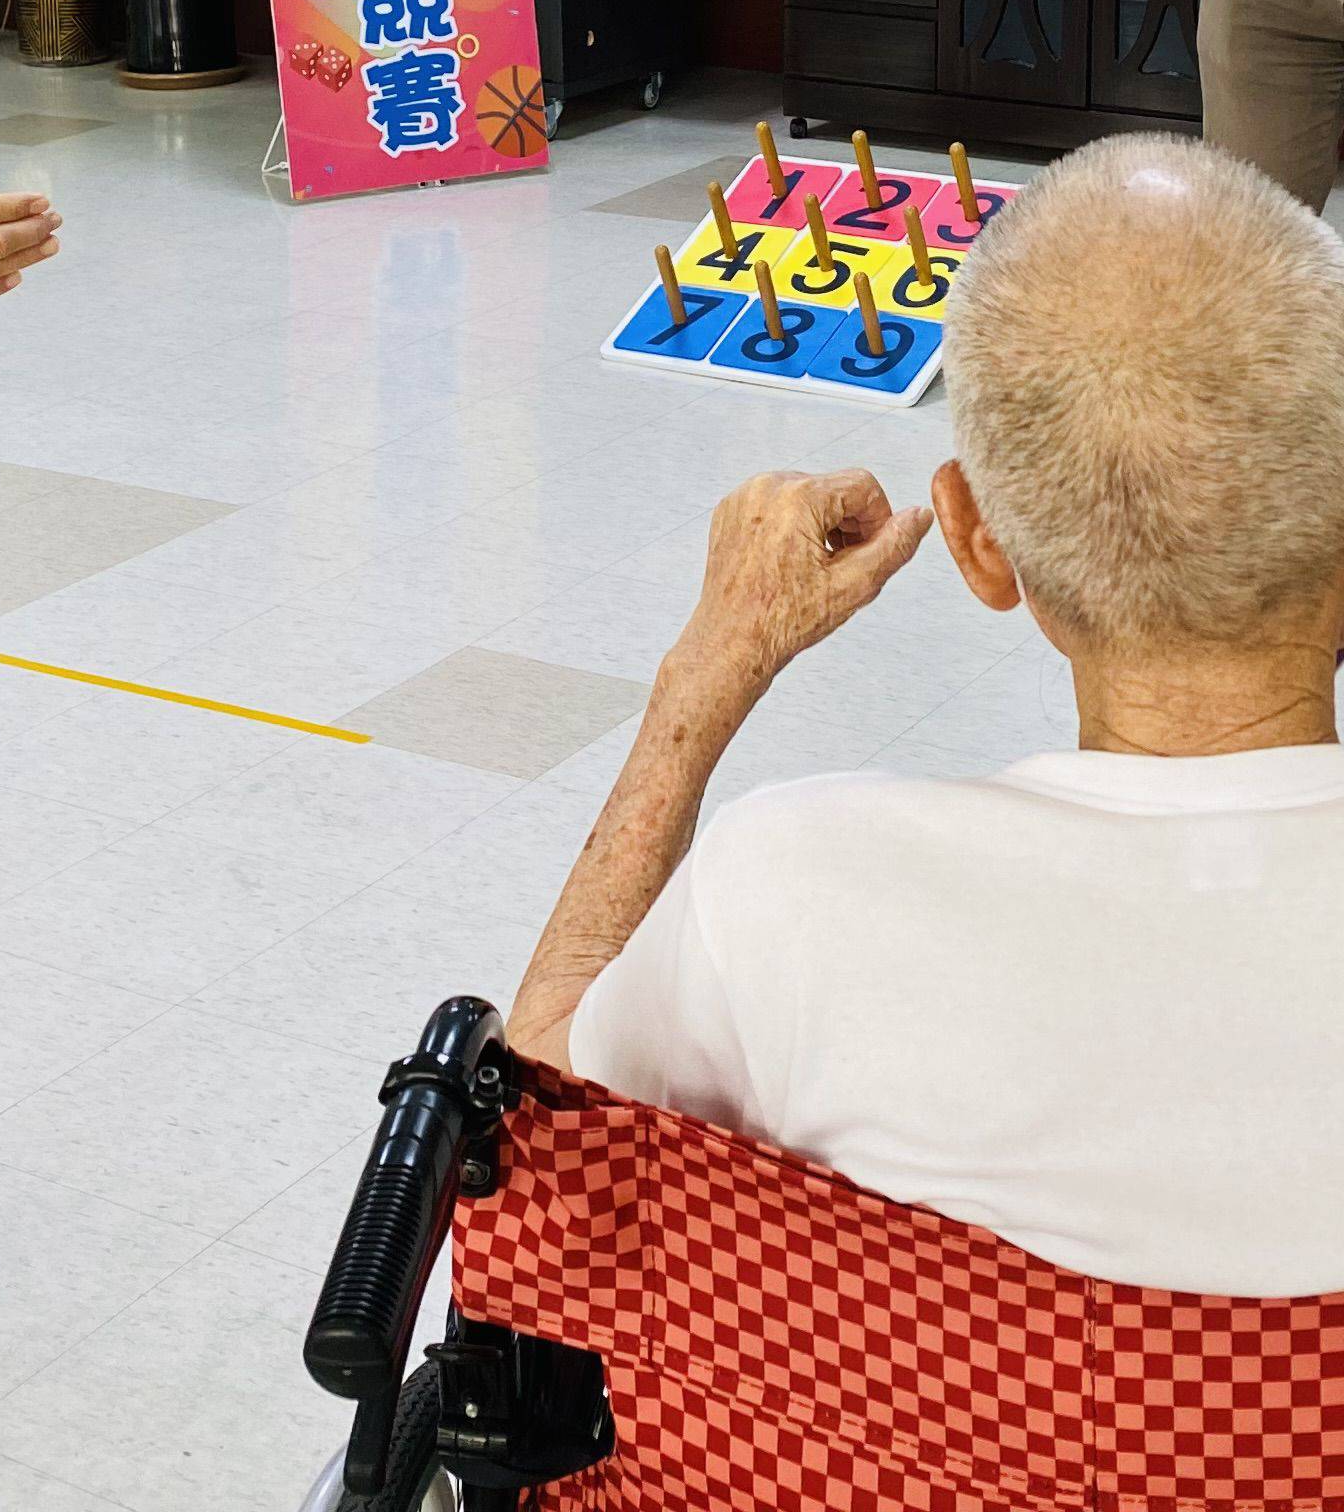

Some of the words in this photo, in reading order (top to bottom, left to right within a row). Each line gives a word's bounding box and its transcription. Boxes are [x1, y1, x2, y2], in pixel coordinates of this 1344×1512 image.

[759, 169, 806, 220] 1
[832, 179, 913, 231] 2
[936, 191, 1006, 245] 3
[696, 231, 765, 282] 4
[790, 241, 870, 295] 5
[892, 256, 960, 309] 6
[646, 292, 726, 346] 7
[740, 307, 817, 363] 8
[839, 321, 915, 378] 9
